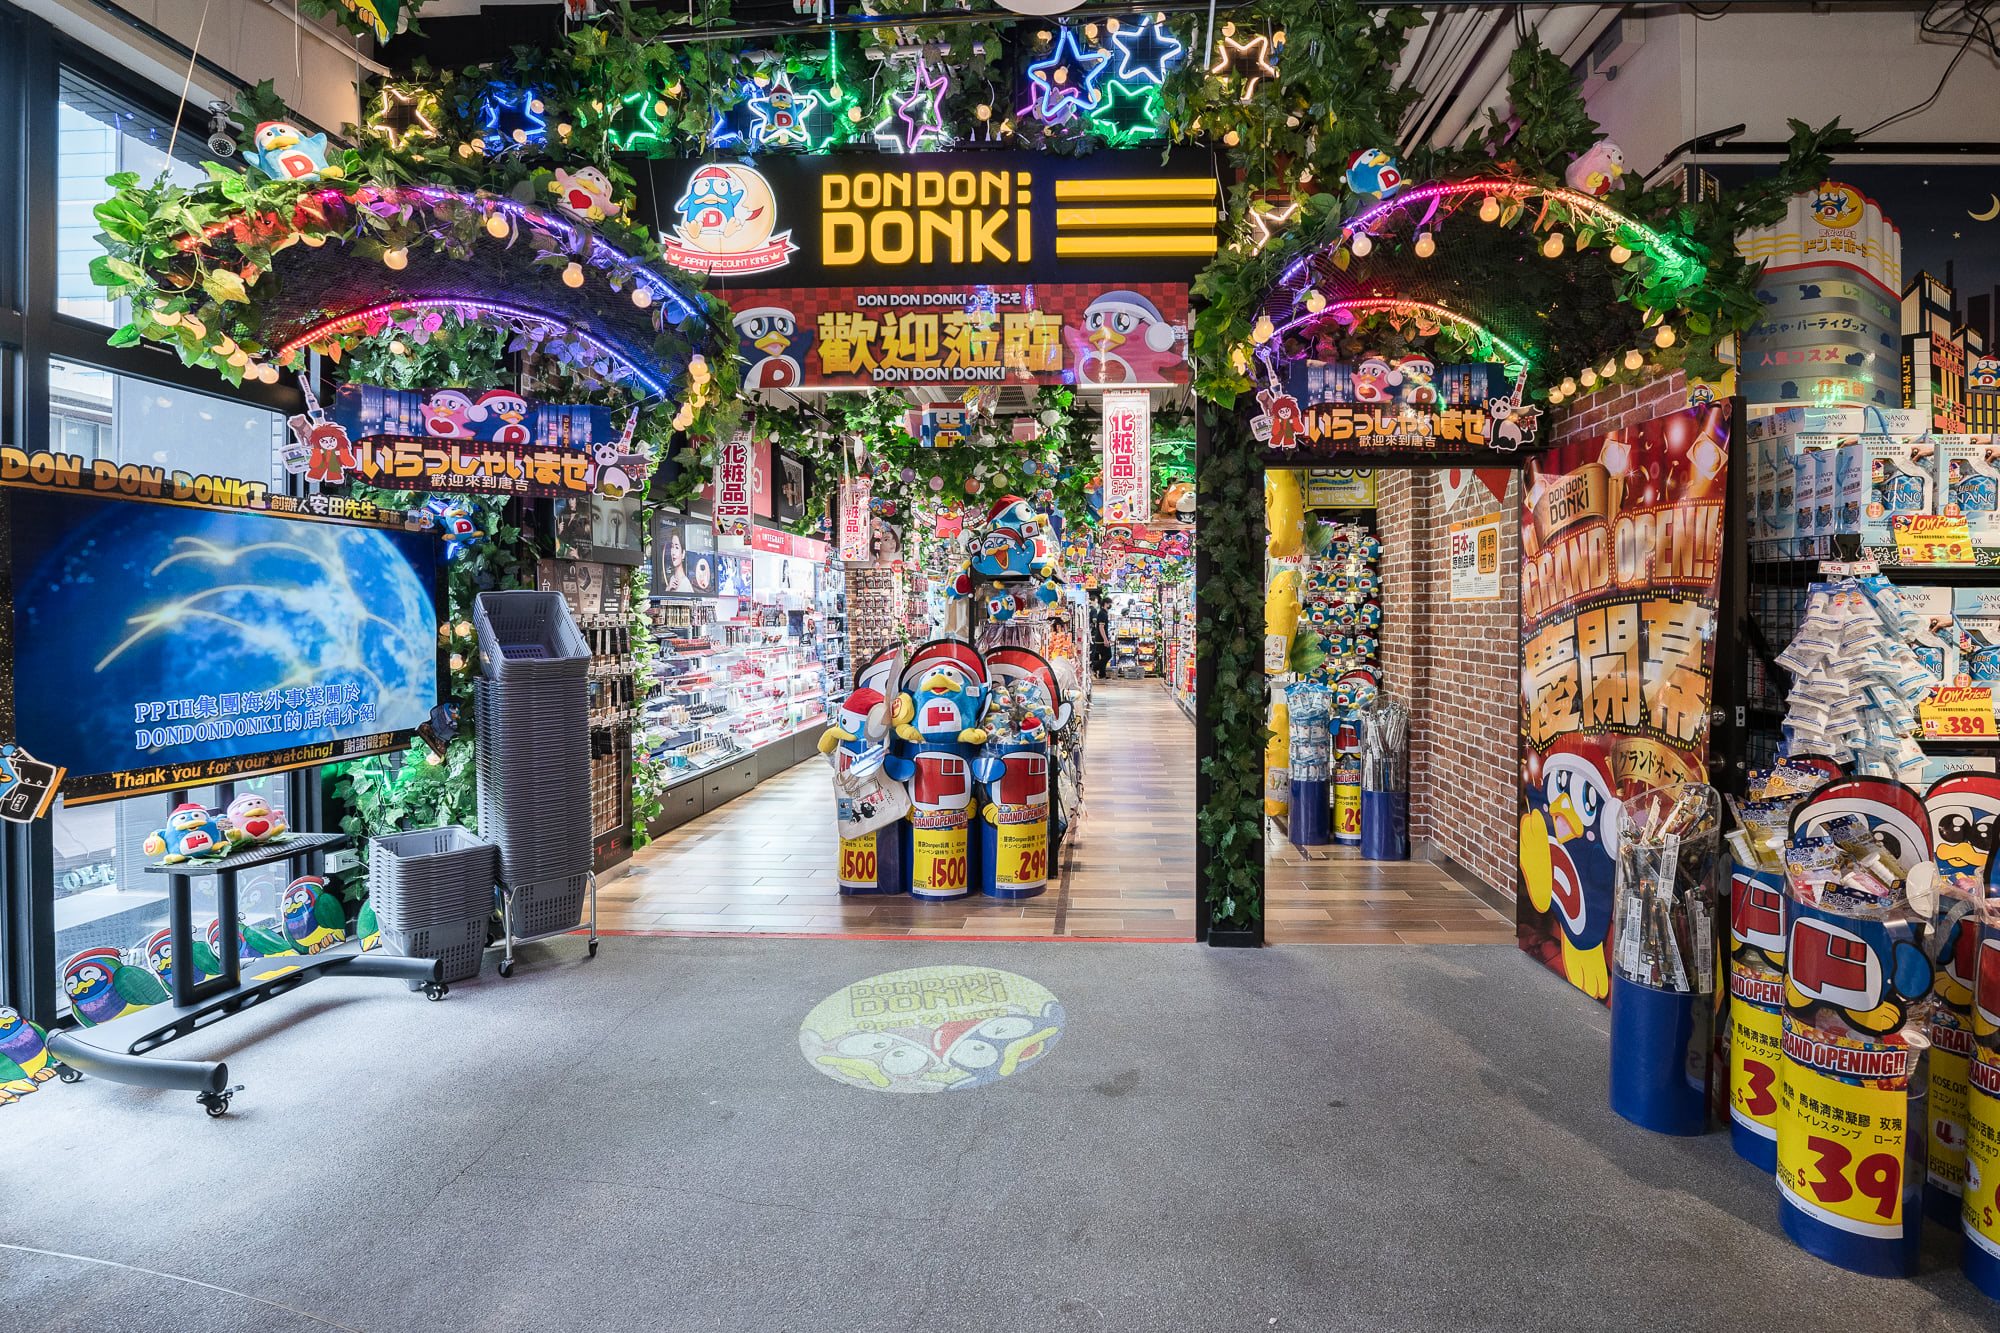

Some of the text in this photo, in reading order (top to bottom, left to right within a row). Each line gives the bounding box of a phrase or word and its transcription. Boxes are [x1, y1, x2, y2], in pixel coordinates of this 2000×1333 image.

[822, 209, 1031, 265] DONKI
[749, 255, 769, 266] KING
[857, 294, 889, 306] DON
[890, 294, 920, 306] DON
[922, 293, 967, 306] DONKI
[873, 366, 1006, 382] DON DON DONKI
[1110, 408, 1136, 479] 化粧品
[1309, 408, 1486, 445] いらっしゃいませ
[1359, 433, 1437, 448] 歡迎來到唐吉
[1, 447, 269, 511] DON DON DONKI
[362, 441, 590, 491] いらっしゃいませ
[430, 473, 530, 491] 歡迎來到唐吉
[721, 443, 747, 504] 化粧品
[718, 506, 748, 515] コーナー
[1523, 504, 1721, 619] GRAND OPEN!!
[1944, 716, 1985, 734] $389
[112, 745, 334, 790] Thank you for your watching!
[1943, 763, 1974, 771] NANOX
[1814, 1043, 1907, 1076] OPENING!!
[1797, 1108, 1903, 1146] トイレスタンプ ローズ
[1799, 1093, 1871, 1128] 馬桶清潔凝膠
[1879, 1117, 1903, 1132] 玫瑰
